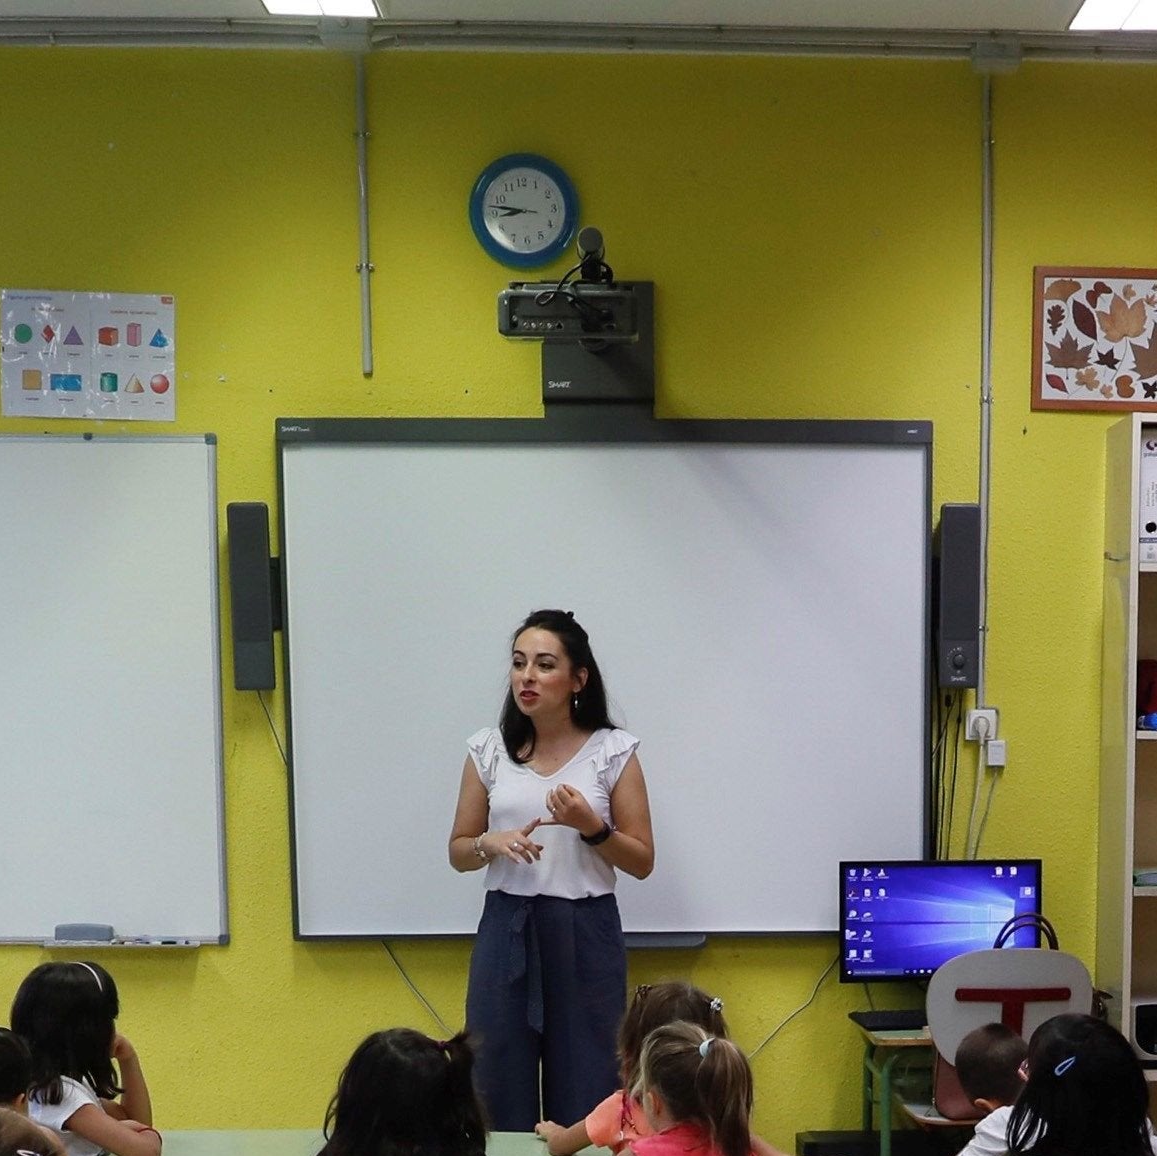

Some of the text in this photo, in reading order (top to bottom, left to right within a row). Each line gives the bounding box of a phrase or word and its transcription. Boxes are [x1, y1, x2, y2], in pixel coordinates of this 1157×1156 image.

[516, 177, 527, 187] 12
[533, 180, 538, 189] 1
[504, 183, 514, 192] 11
[544, 190, 551, 199] 2
[495, 195, 506, 204] 10
[551, 204, 557, 213] 3
[491, 210, 498, 218] 9
[547, 219, 553, 228] 4
[510, 233, 516, 243] 7
[524, 235, 531, 245] 6
[537, 231, 544, 240] 5
